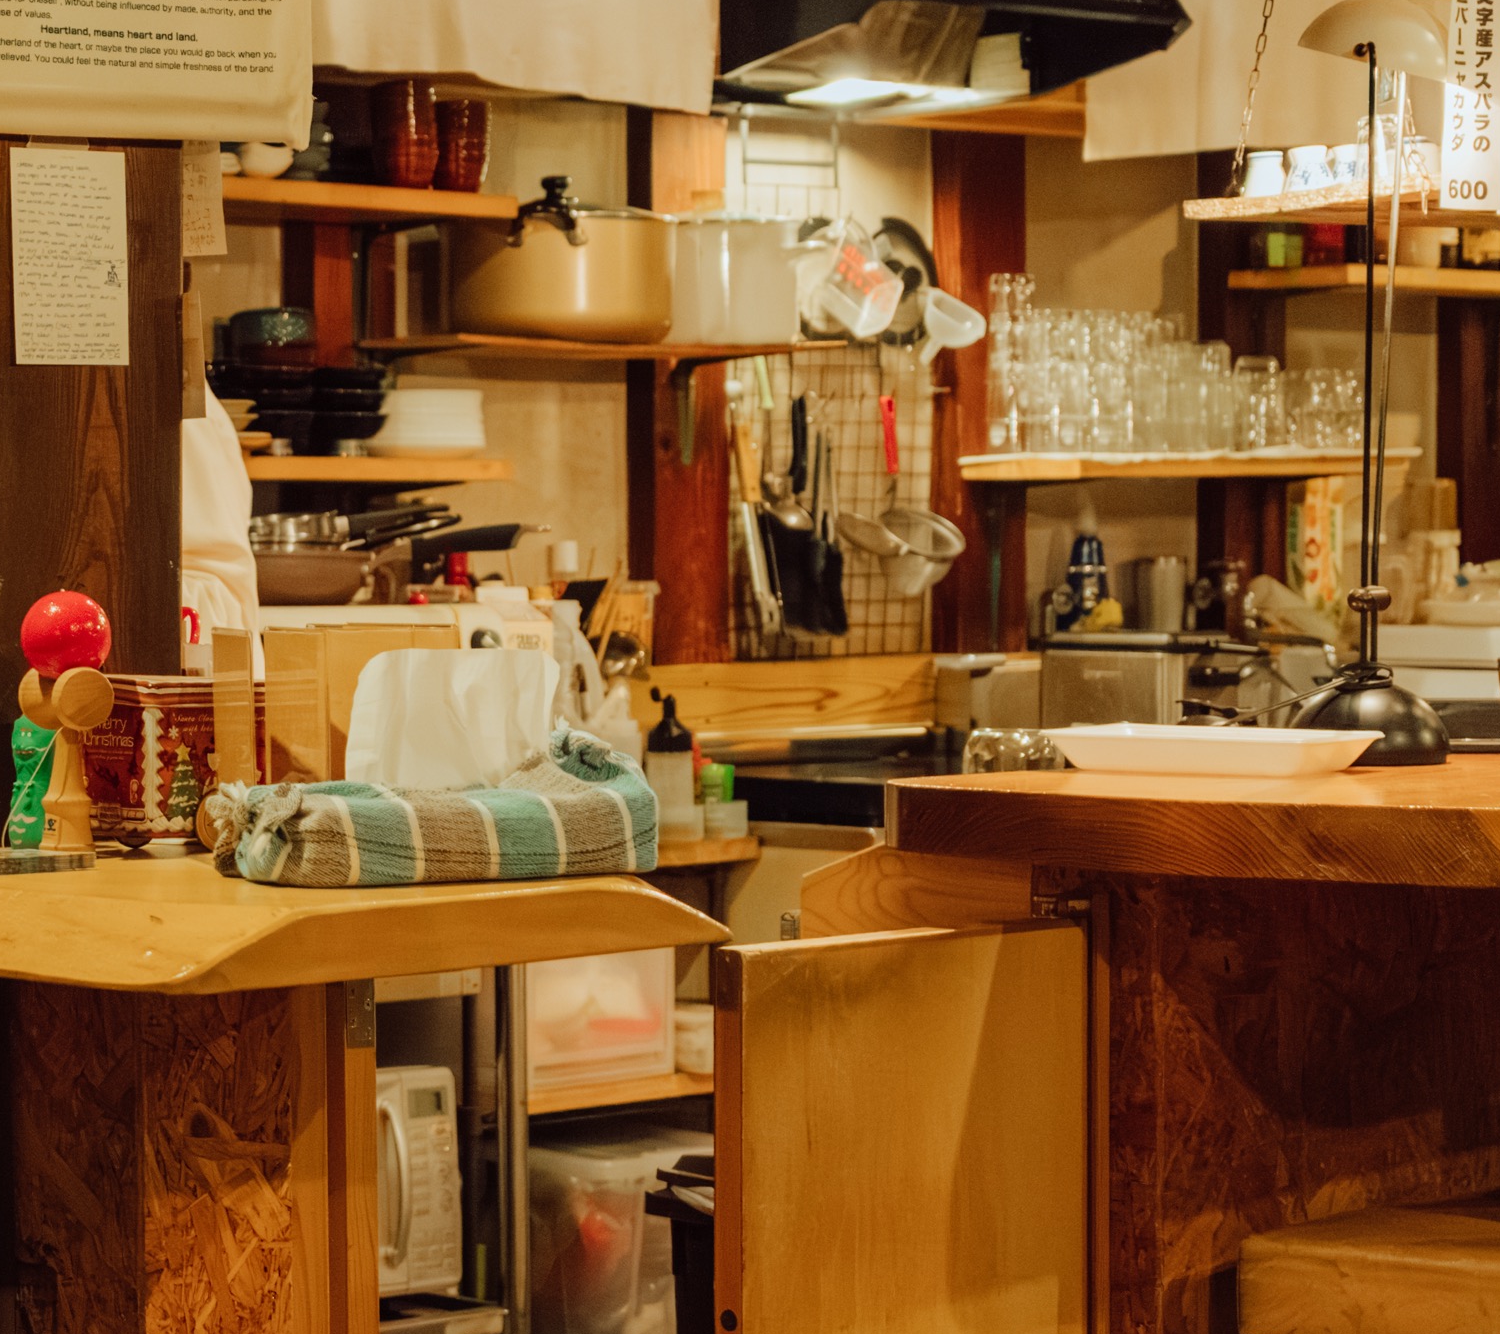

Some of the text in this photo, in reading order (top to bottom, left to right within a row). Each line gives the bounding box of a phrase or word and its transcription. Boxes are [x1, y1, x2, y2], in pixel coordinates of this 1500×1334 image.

[13, 9, 22, 17] of
[162, 3, 172, 13] by
[238, 7, 254, 16] and
[257, 7, 272, 16] the
[40, 24, 198, 42] Heartland, means heart and land.
[34, 40, 42, 48] of
[204, 49, 214, 59] go
[35, 54, 50, 63] You
[93, 57, 106, 66] the
[108, 59, 137, 68] natural
[234, 64, 248, 73] the
[1448, 179, 1488, 201] 600
